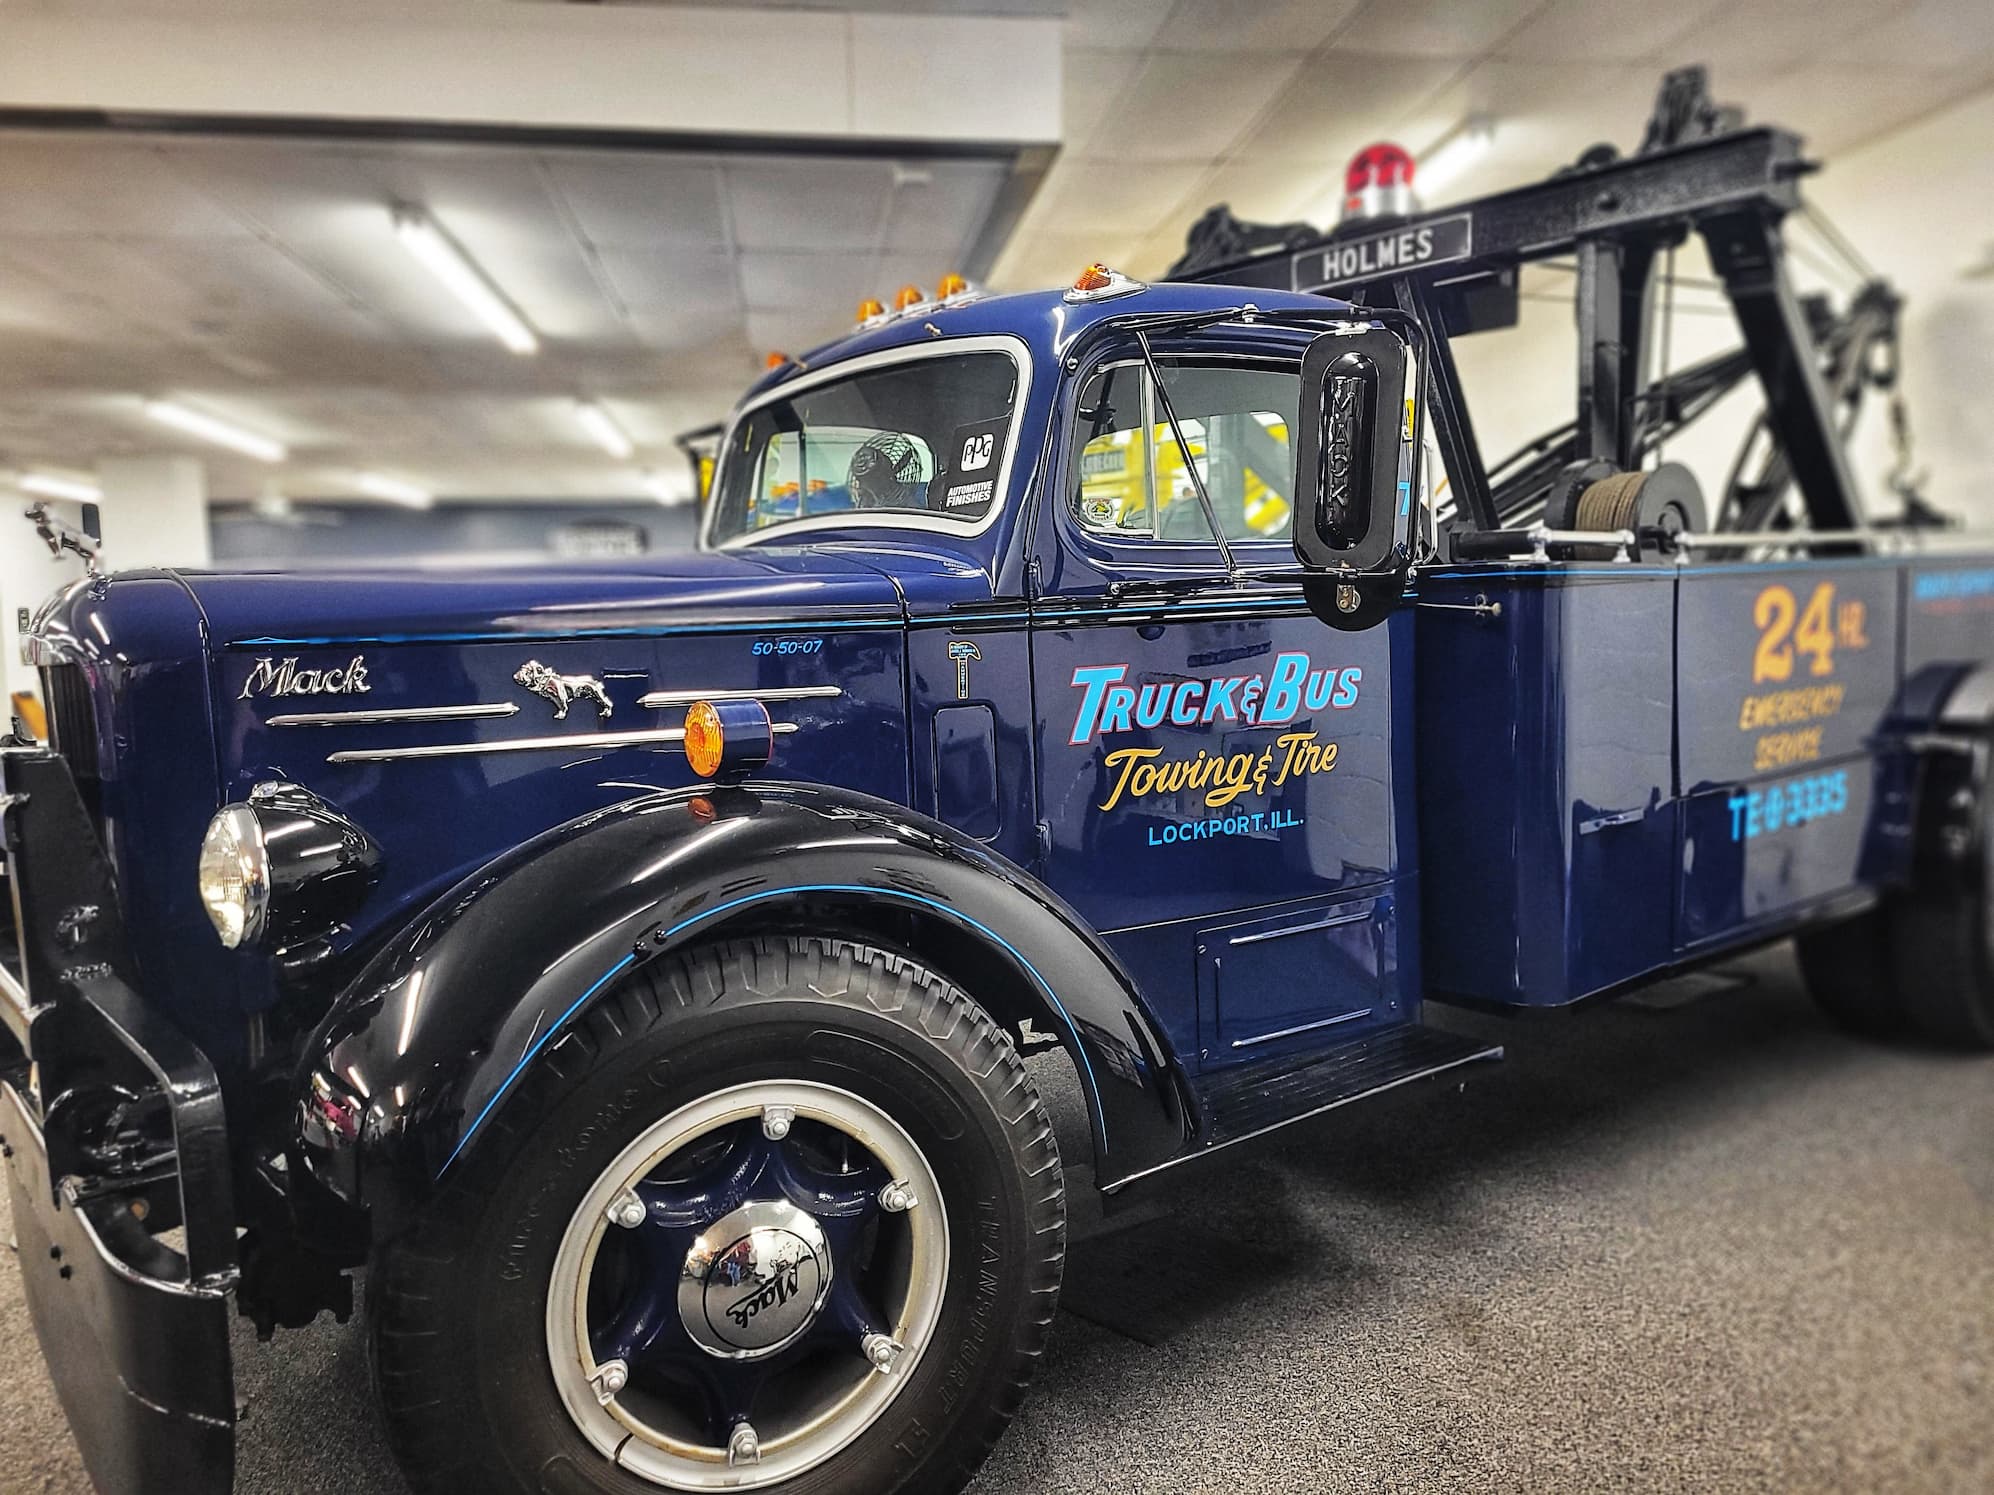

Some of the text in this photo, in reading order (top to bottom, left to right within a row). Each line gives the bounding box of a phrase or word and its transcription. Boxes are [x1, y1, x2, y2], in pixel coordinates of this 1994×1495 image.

[1323, 228, 1433, 281] HOLMES
[962, 436, 993, 467] PPG
[946, 490, 991, 507] FINISHES
[947, 480, 994, 497] AUTOMOTIVE
[751, 640, 823, 655] 50-50-07
[1753, 581, 1837, 685] 24
[237, 655, 372, 700] Mack
[1740, 685, 1844, 731] EMERGENCY
[1097, 730, 1338, 812] Towing & Tire
[726, 1255, 806, 1328] Mack
